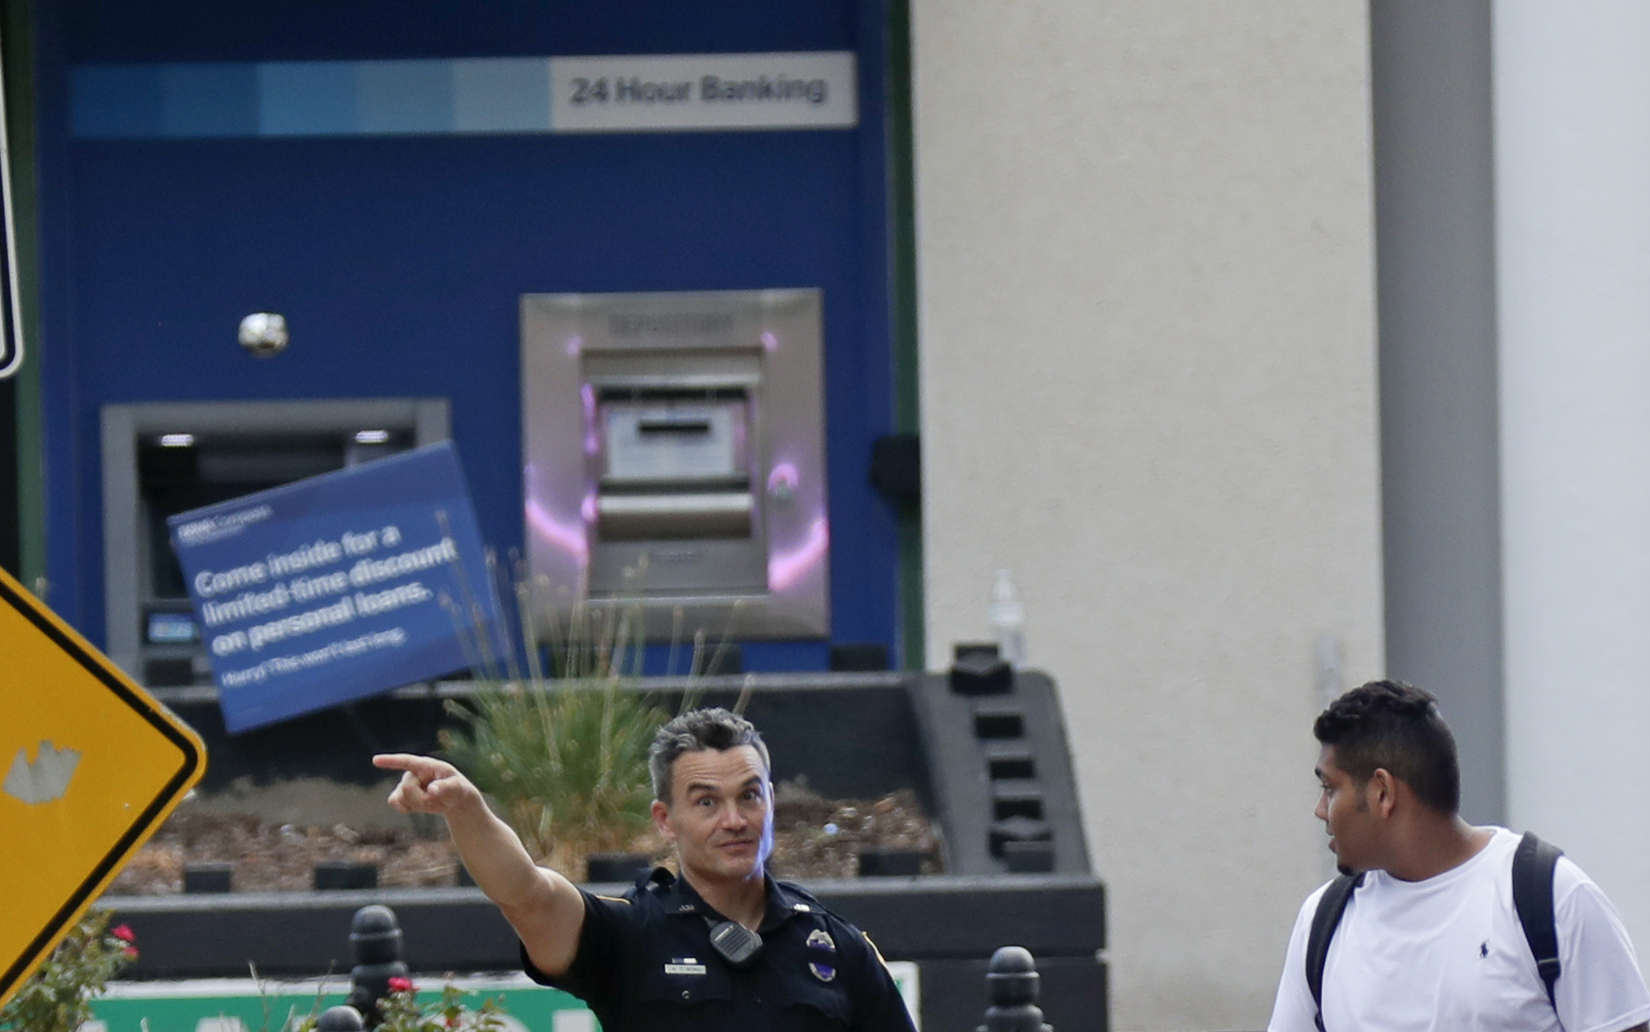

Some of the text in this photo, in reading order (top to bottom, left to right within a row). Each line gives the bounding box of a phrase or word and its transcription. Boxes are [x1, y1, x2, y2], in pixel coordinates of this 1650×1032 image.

[567, 72, 828, 104] 24 Hour Banking
[195, 525, 400, 597] Come inside for a
[348, 537, 457, 587] discount
[212, 630, 249, 657] on
[248, 596, 356, 650] personal
[354, 581, 433, 617] loans.
